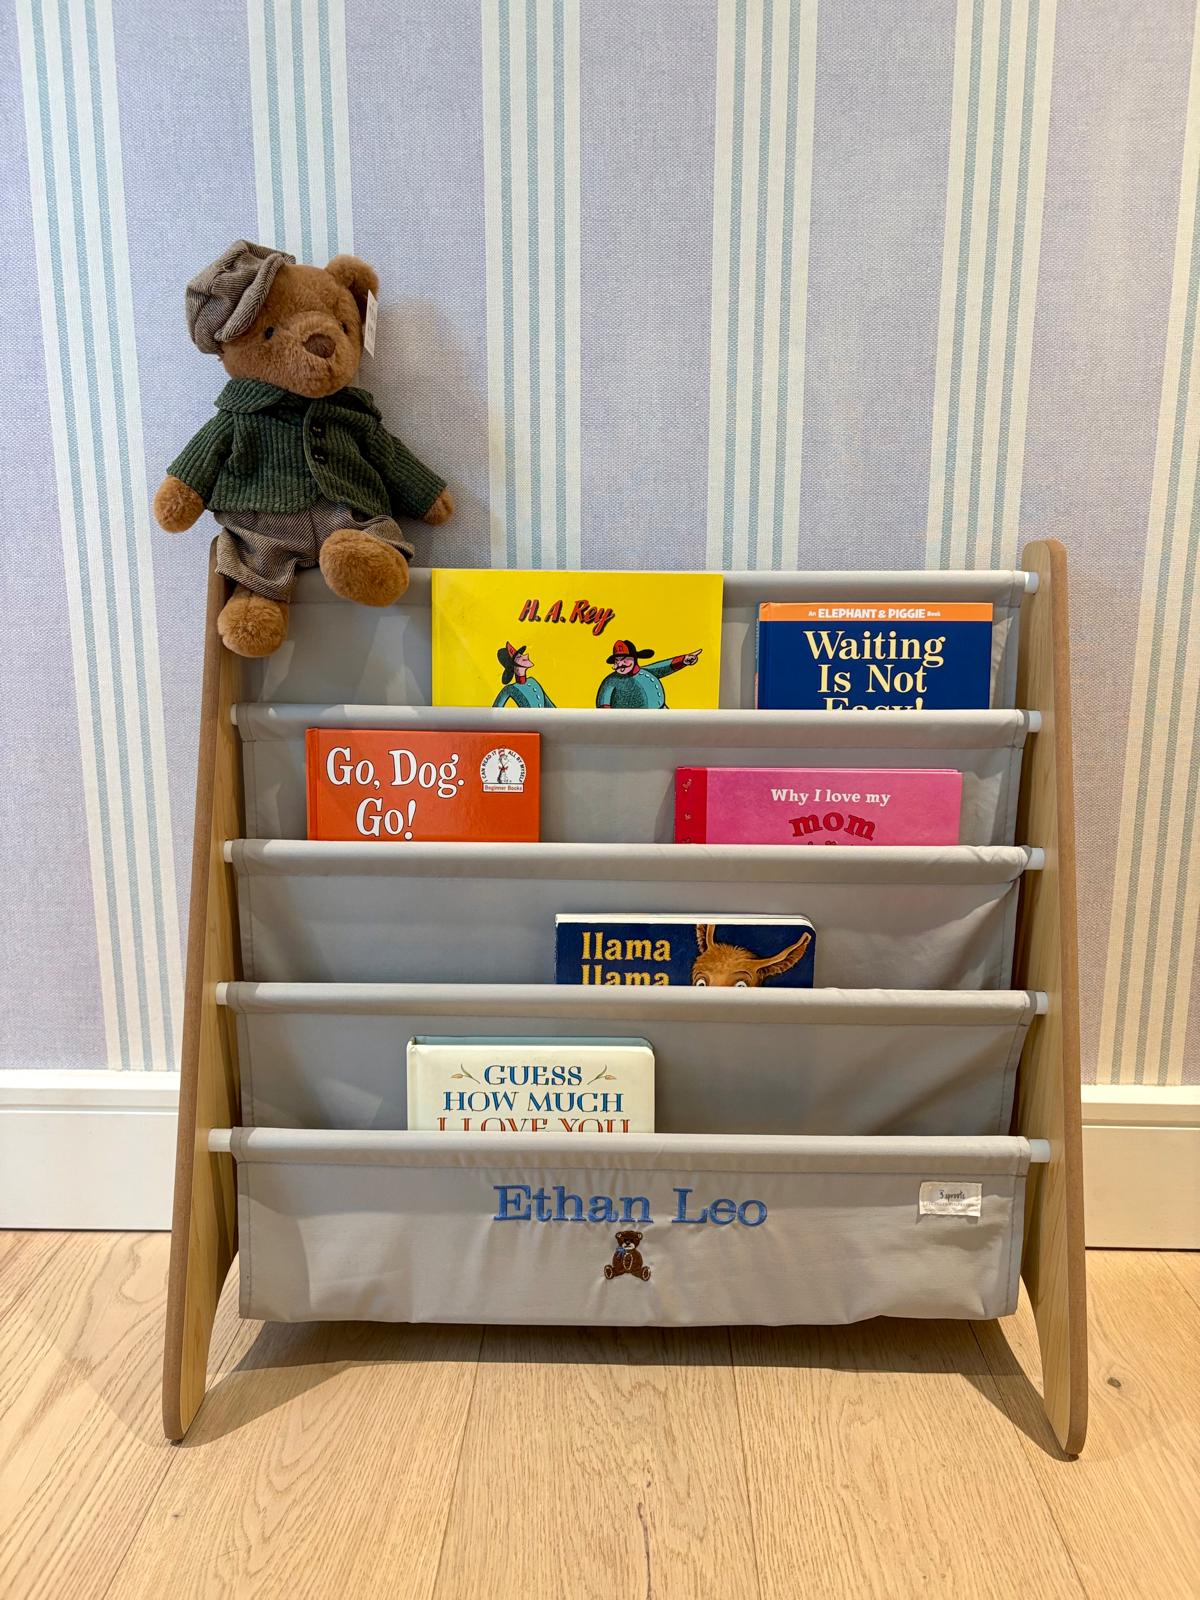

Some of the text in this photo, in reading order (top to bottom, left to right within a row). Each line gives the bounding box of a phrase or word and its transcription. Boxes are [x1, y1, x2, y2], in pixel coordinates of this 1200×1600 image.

[518, 599, 616, 636] H. A. Rey
[818, 608, 877, 618] ELEPHANT
[879, 609, 886, 618] &
[888, 608, 926, 618] PIGGIE
[803, 630, 946, 668] Waiting
[817, 664, 927, 693] Is Not
[326, 746, 465, 799] Go, Dog.
[771, 789, 891, 807] Why I love my
[356, 797, 417, 840] Go!
[789, 812, 876, 841] mom
[582, 931, 672, 962] llama
[484, 1064, 583, 1086] GUESS
[443, 1091, 624, 1113] HOW MUCH
[493, 1184, 768, 1227] Ethan Leo
